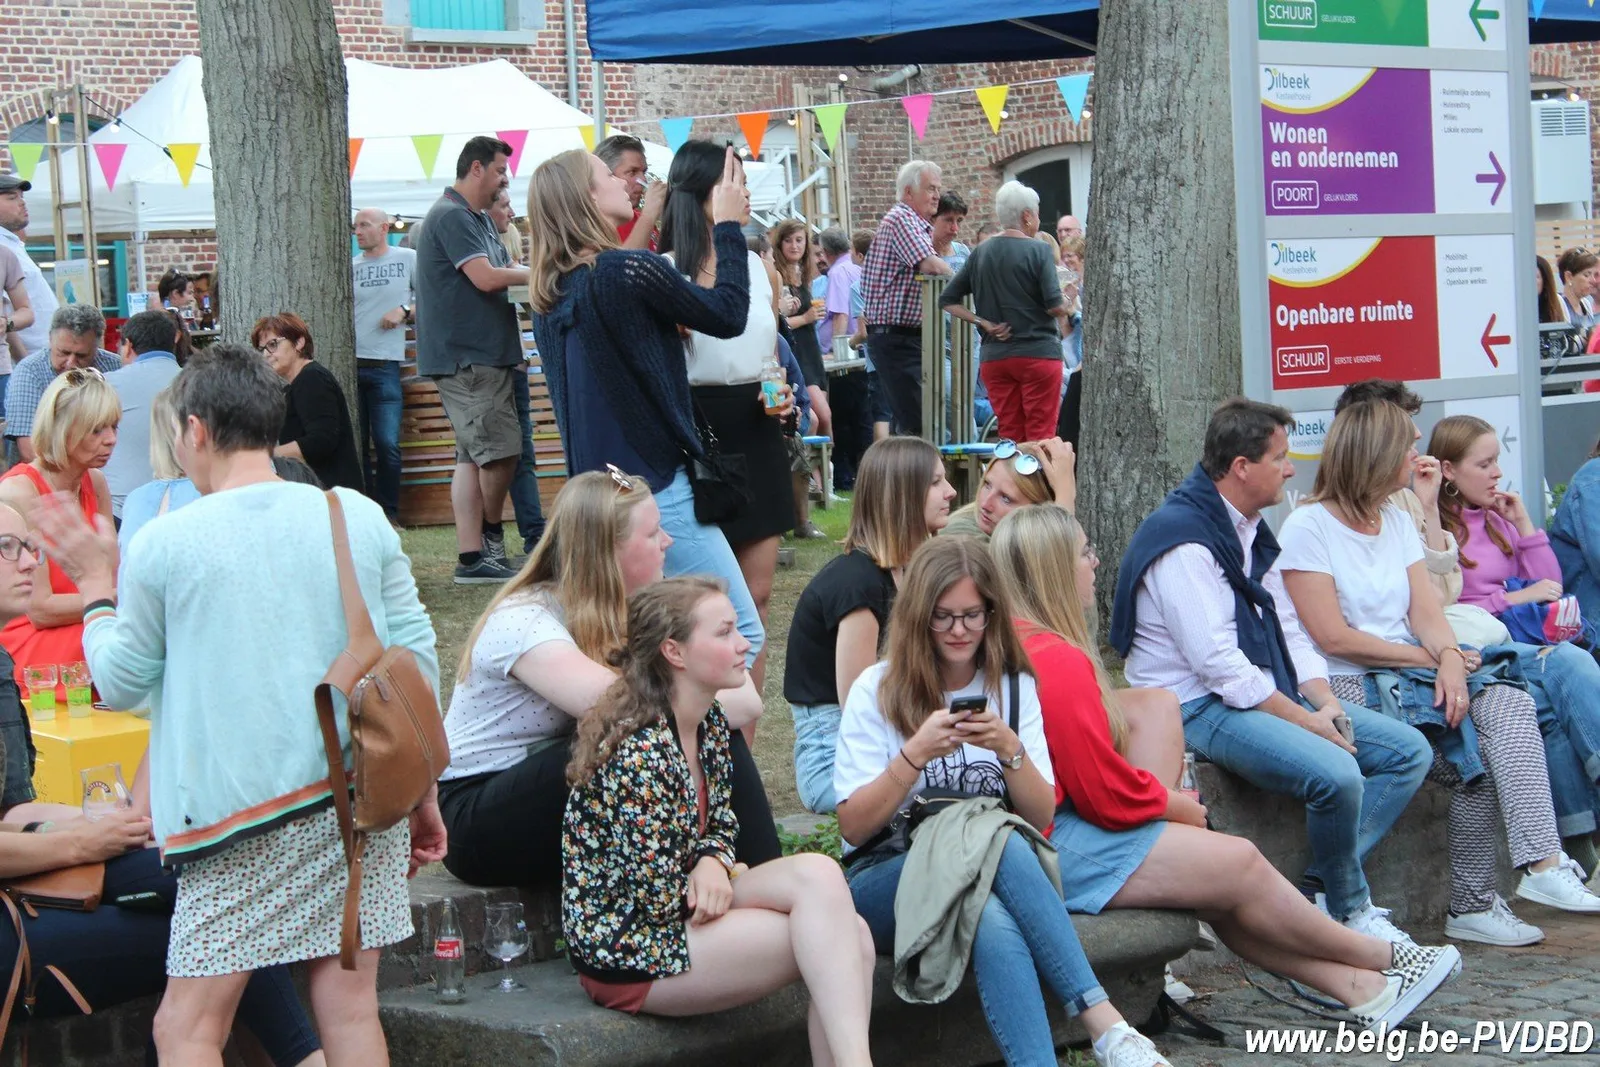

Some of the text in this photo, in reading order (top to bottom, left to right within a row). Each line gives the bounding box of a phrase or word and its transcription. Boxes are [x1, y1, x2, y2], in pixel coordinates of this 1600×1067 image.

[1268, 4, 1313, 21] SCHUUR
[1264, 67, 1310, 91] Dilbeek
[1269, 121, 1328, 144] Wonen
[1271, 146, 1399, 168] en ondernemen
[1277, 187, 1314, 202] POORT
[1271, 242, 1317, 266] Dilbeek
[1276, 300, 1413, 331] Openbare ruimte
[1281, 352, 1325, 368] SCHUUR
